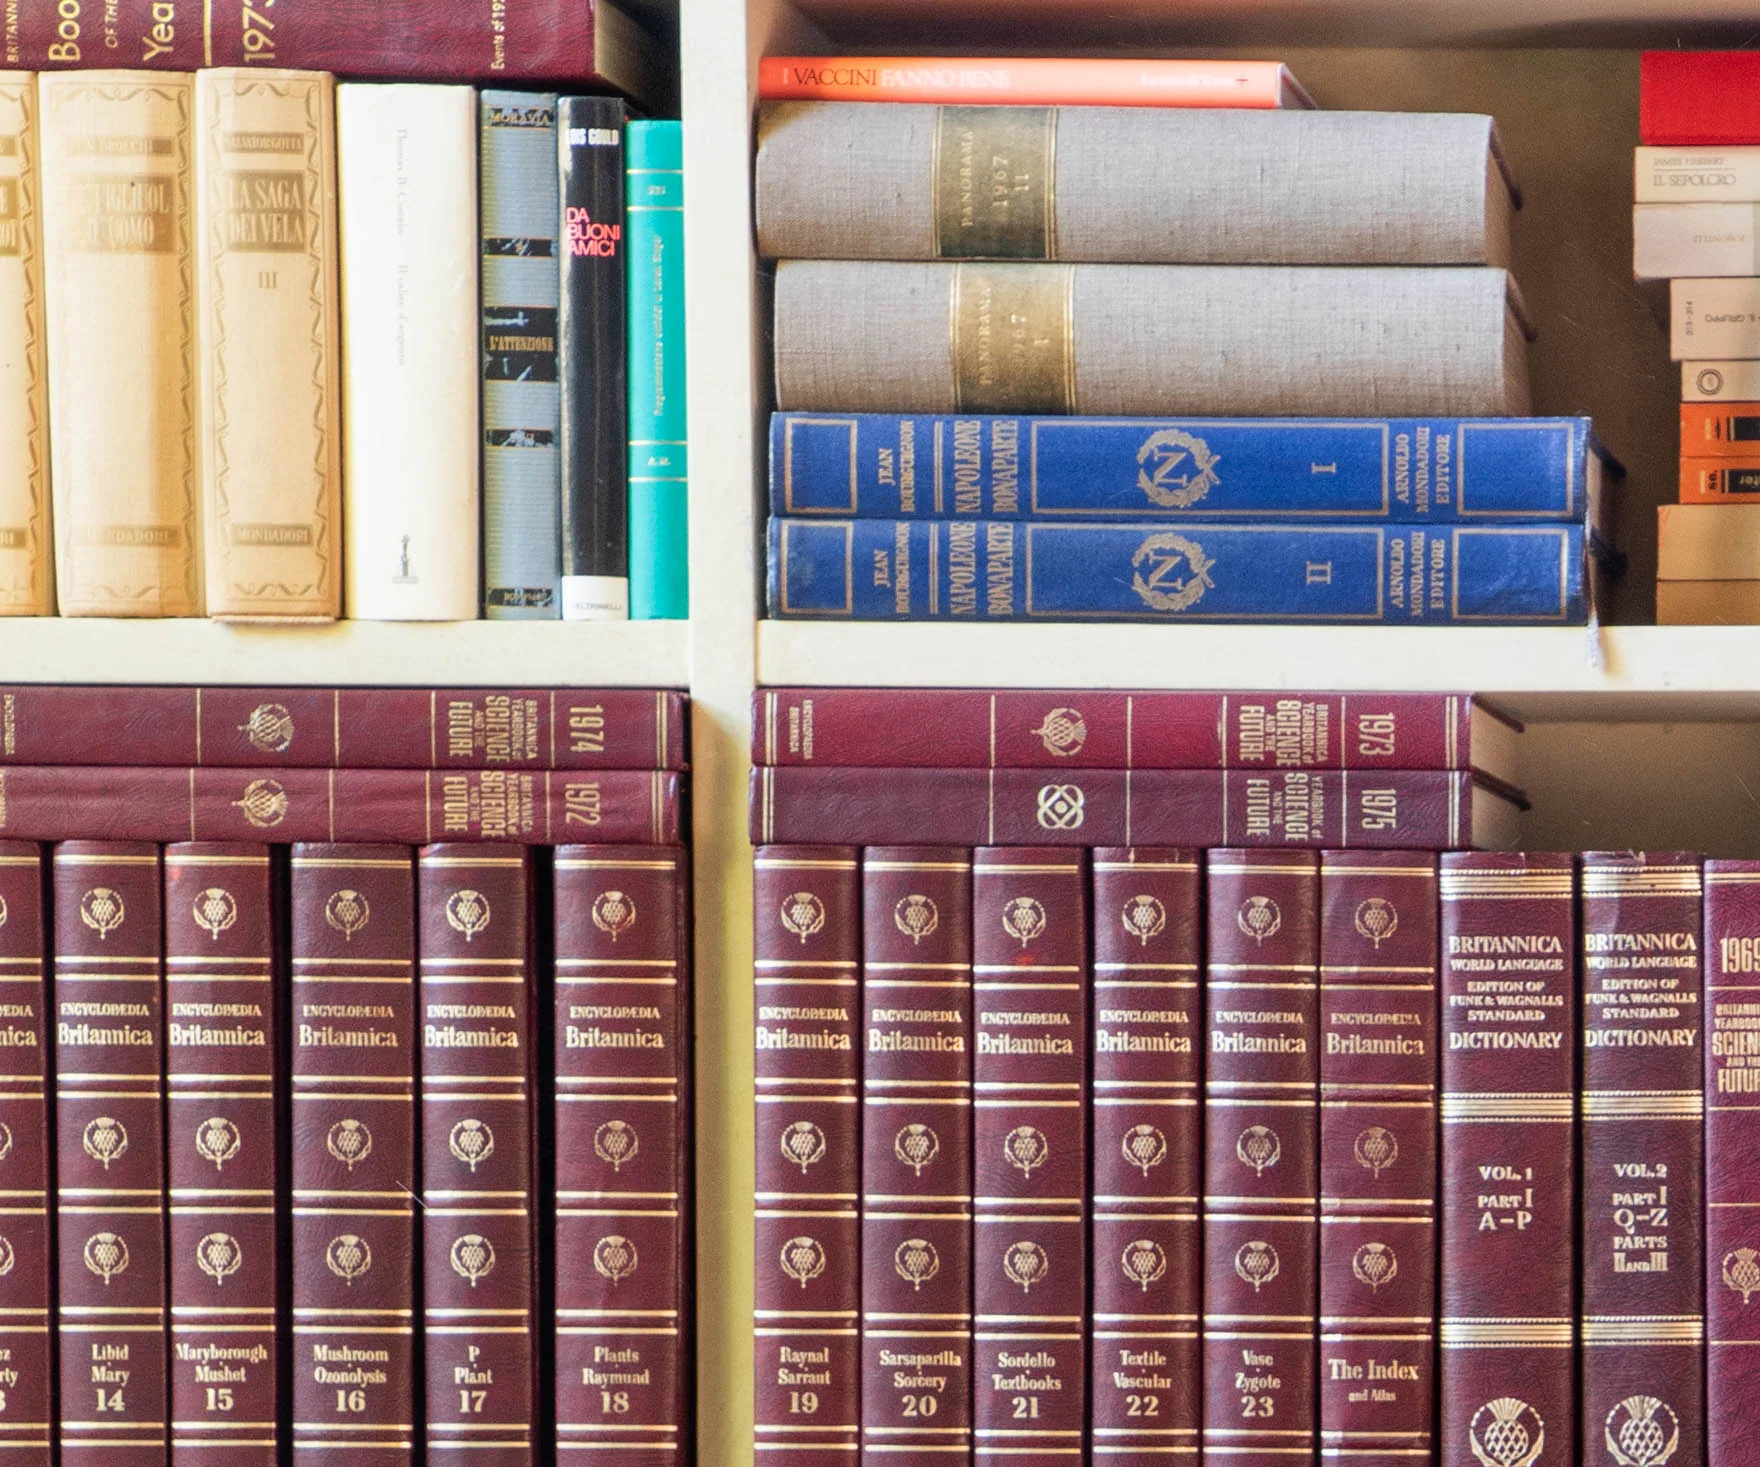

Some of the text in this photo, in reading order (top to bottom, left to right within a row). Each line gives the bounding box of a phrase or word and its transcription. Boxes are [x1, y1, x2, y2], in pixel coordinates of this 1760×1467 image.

[794, 68, 877, 87] VACCINI
[587, 129, 619, 145] GOULD
[961, 131, 974, 227] PANORAMA
[992, 156, 1006, 208] 1967
[1670, 175, 1736, 186] SEPOLCRO
[257, 178, 301, 210] SAGA
[567, 208, 588, 223] DA
[265, 214, 302, 244] VELA
[567, 224, 620, 240] BUONI
[568, 240, 616, 256] AMICI
[258, 270, 279, 290] III
[878, 448, 893, 486] JEAN
[901, 420, 914, 512] BOURGUIGNON
[956, 420, 980, 514] NAPOLEONE
[993, 420, 1018, 514] BONAPARTE
[1396, 434, 1411, 504] ARNOLDO
[1416, 427, 1430, 513] MONDADORI
[1437, 435, 1451, 505] EDITORE
[874, 550, 888, 587] JEAN
[895, 522, 909, 613] BOURGUIGNON
[950, 522, 976, 615] NAPOLEONE
[988, 522, 1014, 615] BONAPARTE
[1392, 539, 1405, 608] ARNOLDO
[1410, 532, 1424, 619] MONDADORI
[1431, 539, 1445, 609] EDITORE
[449, 701, 472, 757] FUTURE
[486, 696, 509, 762] SCIENCE
[569, 705, 603, 752] 1974
[1240, 705, 1264, 760] FUTURE
[1277, 700, 1300, 767] SCIENCE
[1359, 713, 1394, 755] 1973
[444, 776, 467, 832] FUTURE
[481, 771, 504, 837] SCIENCE
[565, 782, 599, 825] 1972
[1247, 779, 1269, 836] FUTURE
[1285, 773, 1308, 841] SCIENCE
[1362, 789, 1396, 829] 1975
[1449, 936, 1562, 954] BRITANNICA
[1585, 933, 1696, 951] BRITANNICA
[1451, 957, 1564, 971] WORLD LANGUAGE
[1586, 955, 1697, 969] WORLD LANGUAGE
[1468, 980, 1544, 993] EDITION OF
[1602, 979, 1656, 992] EDITION
[1450, 995, 1563, 1007] FUNK WAGNALLS
[1468, 1009, 1545, 1022] STANDARD
[1603, 1007, 1679, 1019] STANDARD
[58, 1027, 152, 1046] Britannica
[169, 1027, 264, 1046] Britannica
[299, 1027, 398, 1048] Britannica
[425, 1027, 518, 1048] Britannica
[565, 1027, 664, 1049] Britannica
[756, 1029, 851, 1050] Britannica
[868, 1030, 964, 1052] Britannica
[978, 1032, 1073, 1054] Britannica
[1096, 1032, 1191, 1054] Britannica
[1212, 1031, 1306, 1054] Britannica
[1326, 1033, 1424, 1056] Britannica
[1449, 1032, 1562, 1050] DICTIONARY
[1585, 1029, 1696, 1048] DICTIONARY
[1479, 1166, 1520, 1181] VOL.
[1478, 1195, 1520, 1208] PART
[1613, 1192, 1655, 1206] PART
[1613, 1236, 1667, 1250] PARTS
[92, 1344, 129, 1361] Libid
[175, 1344, 268, 1364] Maryborough
[313, 1346, 389, 1364] Mushroom
[593, 1347, 640, 1364] Plants
[779, 1346, 830, 1367] Raynal
[879, 1350, 962, 1370] Sarsaparilla
[998, 1352, 1056, 1369] Sordello
[1120, 1351, 1166, 1368] Textile
[1242, 1351, 1273, 1368] Vase
[91, 1366, 130, 1385] Mary
[195, 1366, 246, 1384] Mushet
[314, 1367, 388, 1385] Ozonolysis
[454, 1367, 492, 1384] Plant
[778, 1369, 831, 1386] Sarraut
[1329, 1359, 1419, 1381] The Index
[894, 1371, 946, 1392] Sorcery
[992, 1372, 1062, 1391] Textbooks
[1113, 1372, 1172, 1390] Vascular
[1235, 1372, 1281, 1392] Zygote
[96, 1389, 124, 1411] 14
[206, 1389, 233, 1411] 15
[337, 1390, 365, 1411] 16
[460, 1391, 487, 1412] 17
[602, 1392, 629, 1413] 18
[790, 1394, 819, 1414] 19
[1126, 1396, 1159, 1416] 22
[1349, 1389, 1396, 1402] and Atlas
[902, 1396, 937, 1417] 20
[1012, 1398, 1039, 1418] 21
[1241, 1396, 1274, 1417] 23
